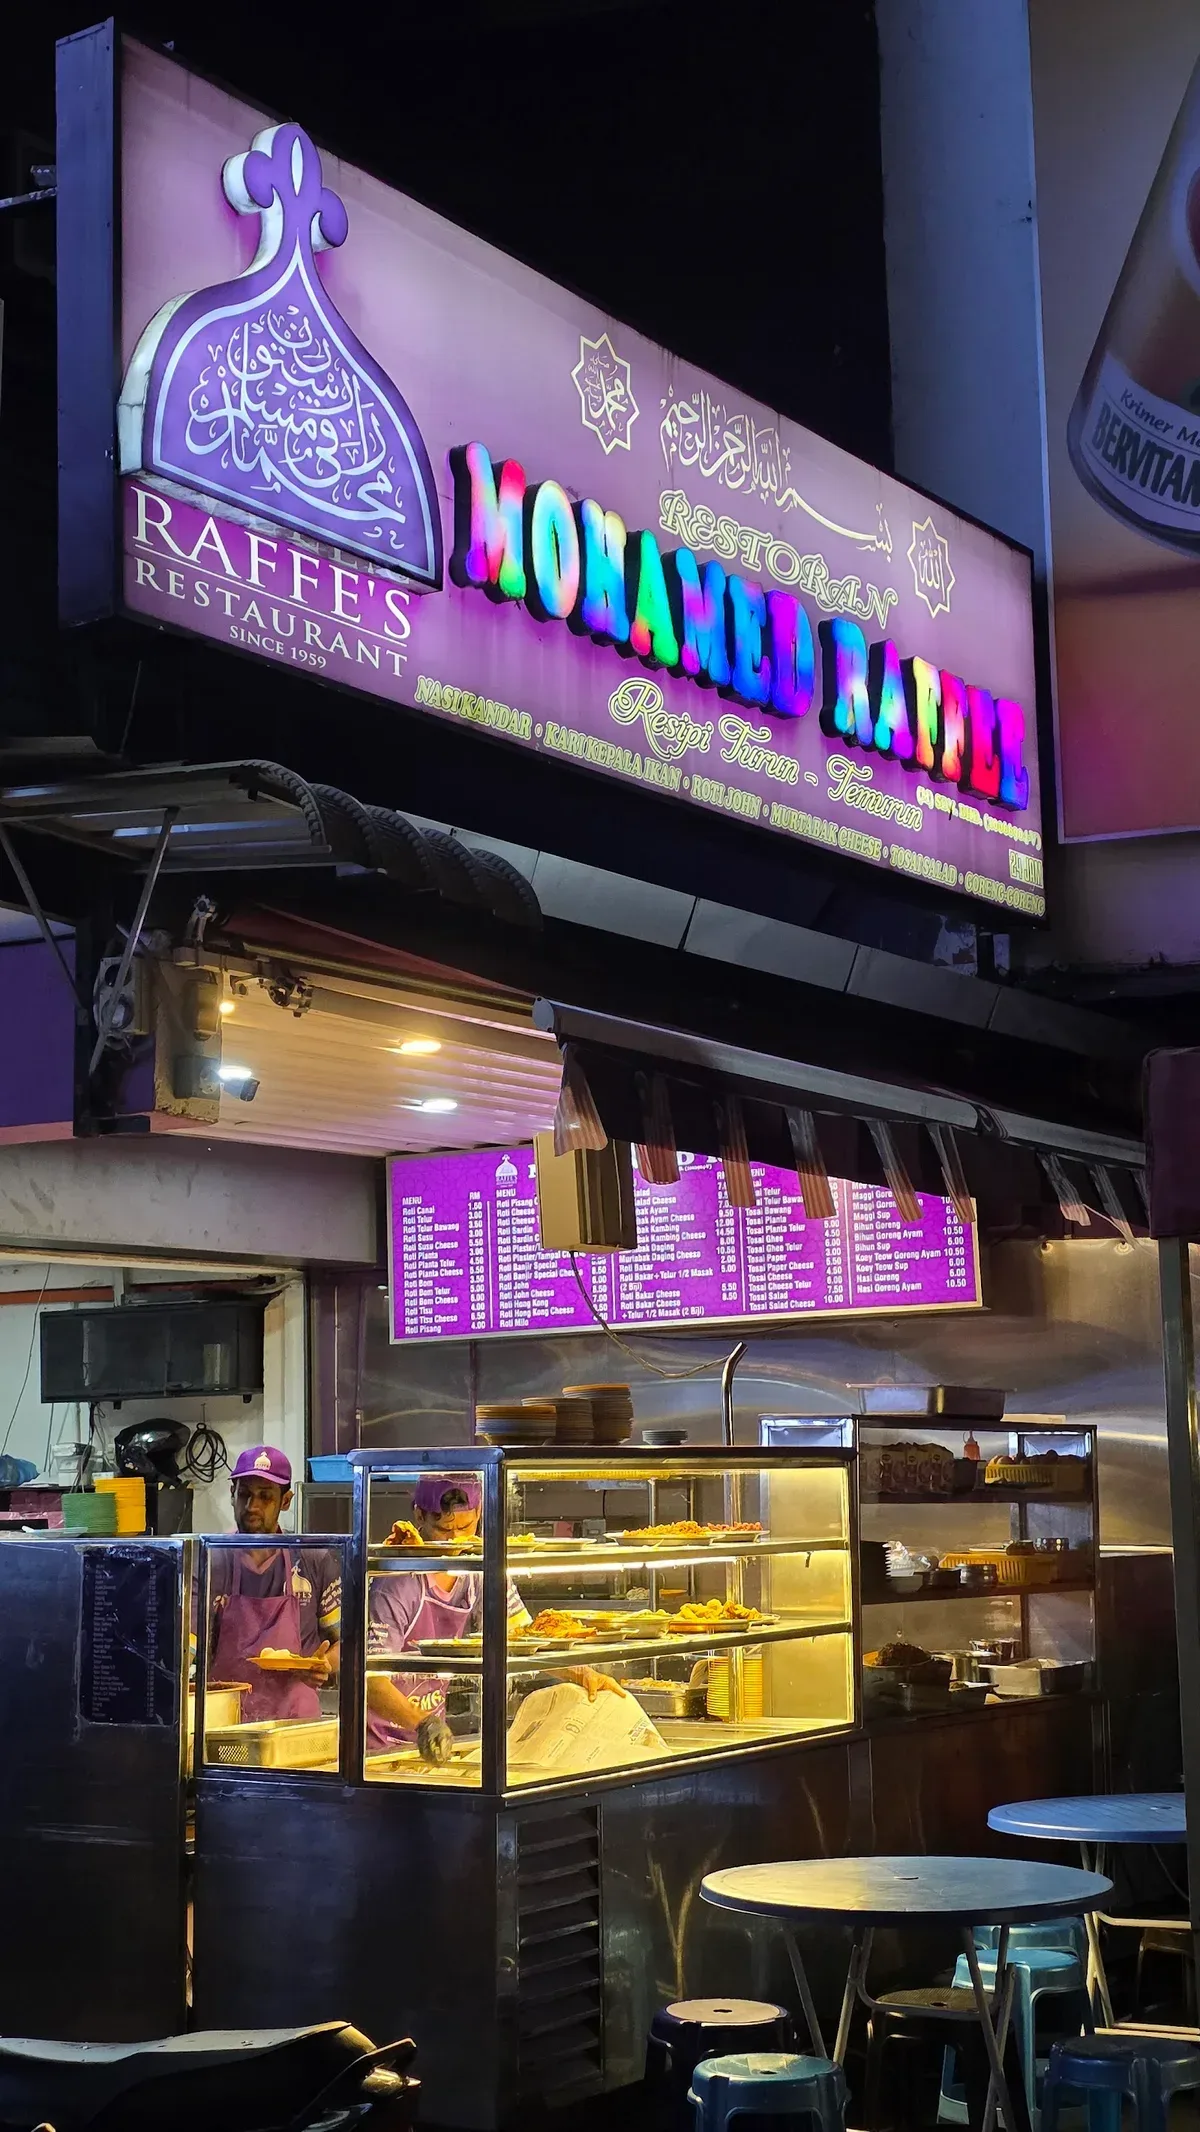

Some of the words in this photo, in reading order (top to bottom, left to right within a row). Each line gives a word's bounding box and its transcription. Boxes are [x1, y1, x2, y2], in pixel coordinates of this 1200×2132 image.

[130, 486, 411, 640] RAFFE'S
[134, 557, 408, 678] RESTAURANT
[449, 440, 814, 719] MOHAMED
[659, 489, 898, 630] RESTORAN
[229, 625, 284, 655] SINCE
[290, 646, 327, 669] 1959
[414, 675, 461, 713] NASI
[460, 690, 534, 740] KANDAR
[543, 721, 587, 757] KARI
[586, 736, 644, 778] KEPALA
[643, 758, 682, 792] IKAN
[692, 775, 726, 807] ROTI
[724, 785, 763, 820] JOHN
[770, 803, 838, 846] MURTABAK
[837, 826, 883, 862] CHEESE
[890, 843, 923, 879] TOSAI
[921, 858, 957, 887] SALAD
[608, 677, 714, 761] Resipi
[718, 713, 799, 786] Turun
[826, 754, 923, 832] Temurun
